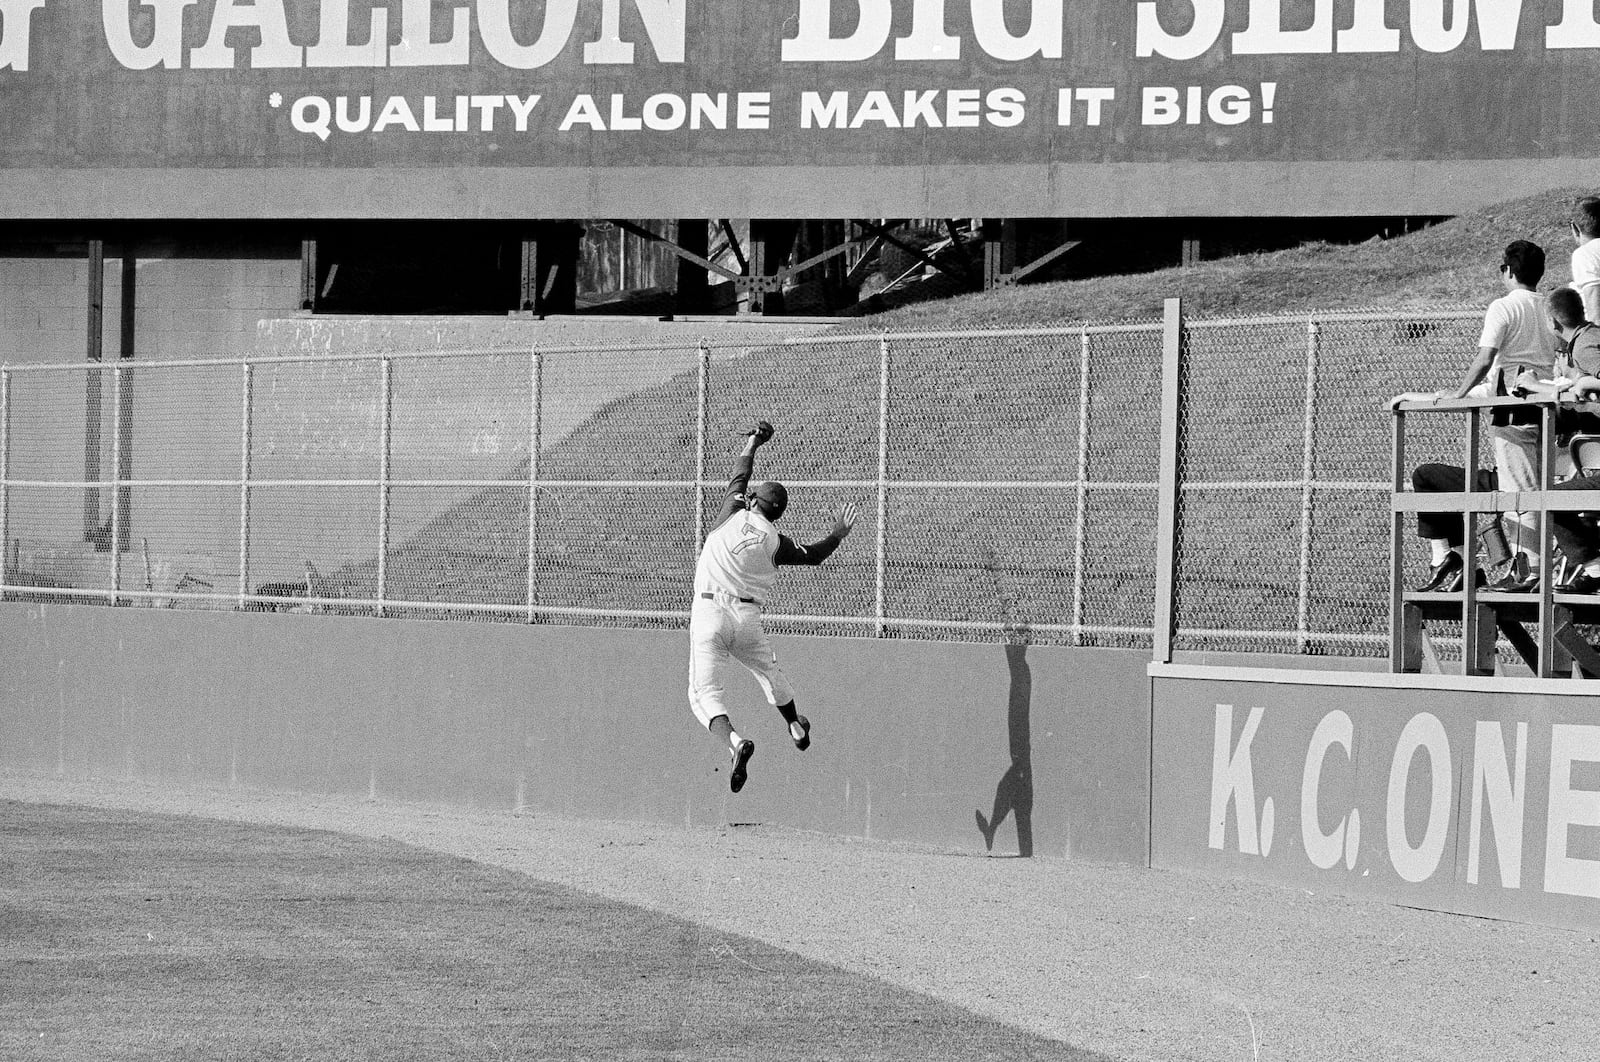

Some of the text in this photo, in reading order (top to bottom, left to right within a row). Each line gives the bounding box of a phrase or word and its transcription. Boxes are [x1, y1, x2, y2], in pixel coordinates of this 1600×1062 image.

[558, 92, 771, 133] ALONE
[800, 86, 1026, 131] MAKES
[1057, 86, 1115, 127] IT
[1141, 82, 1277, 127] BIG!
[732, 523, 767, 555] 7
